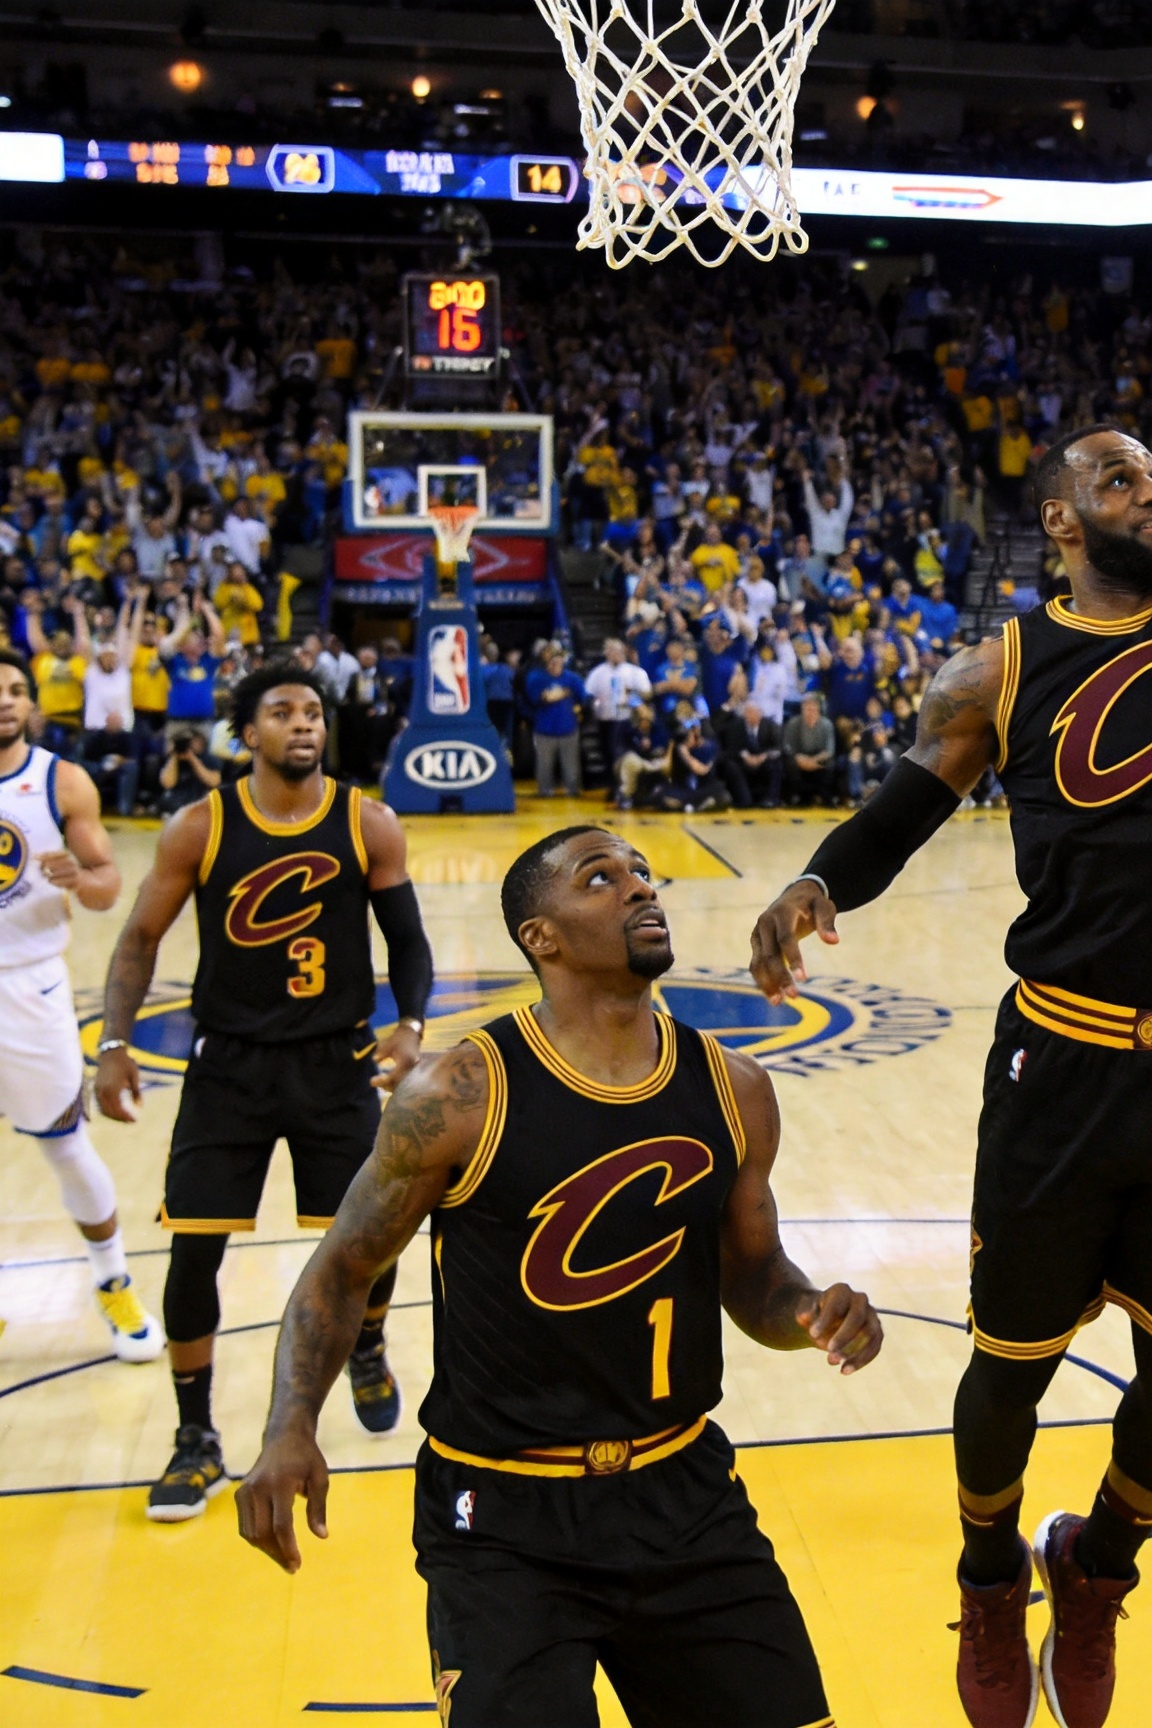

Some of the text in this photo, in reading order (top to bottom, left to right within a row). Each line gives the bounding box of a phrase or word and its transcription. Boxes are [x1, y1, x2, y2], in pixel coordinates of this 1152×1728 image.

[527, 164, 563, 193] 14
[422, 750, 482, 779] KIA
[225, 851, 341, 948] C
[286, 937, 326, 998] 3
[520, 1136, 714, 1311] C
[648, 1298, 673, 1400] 1
